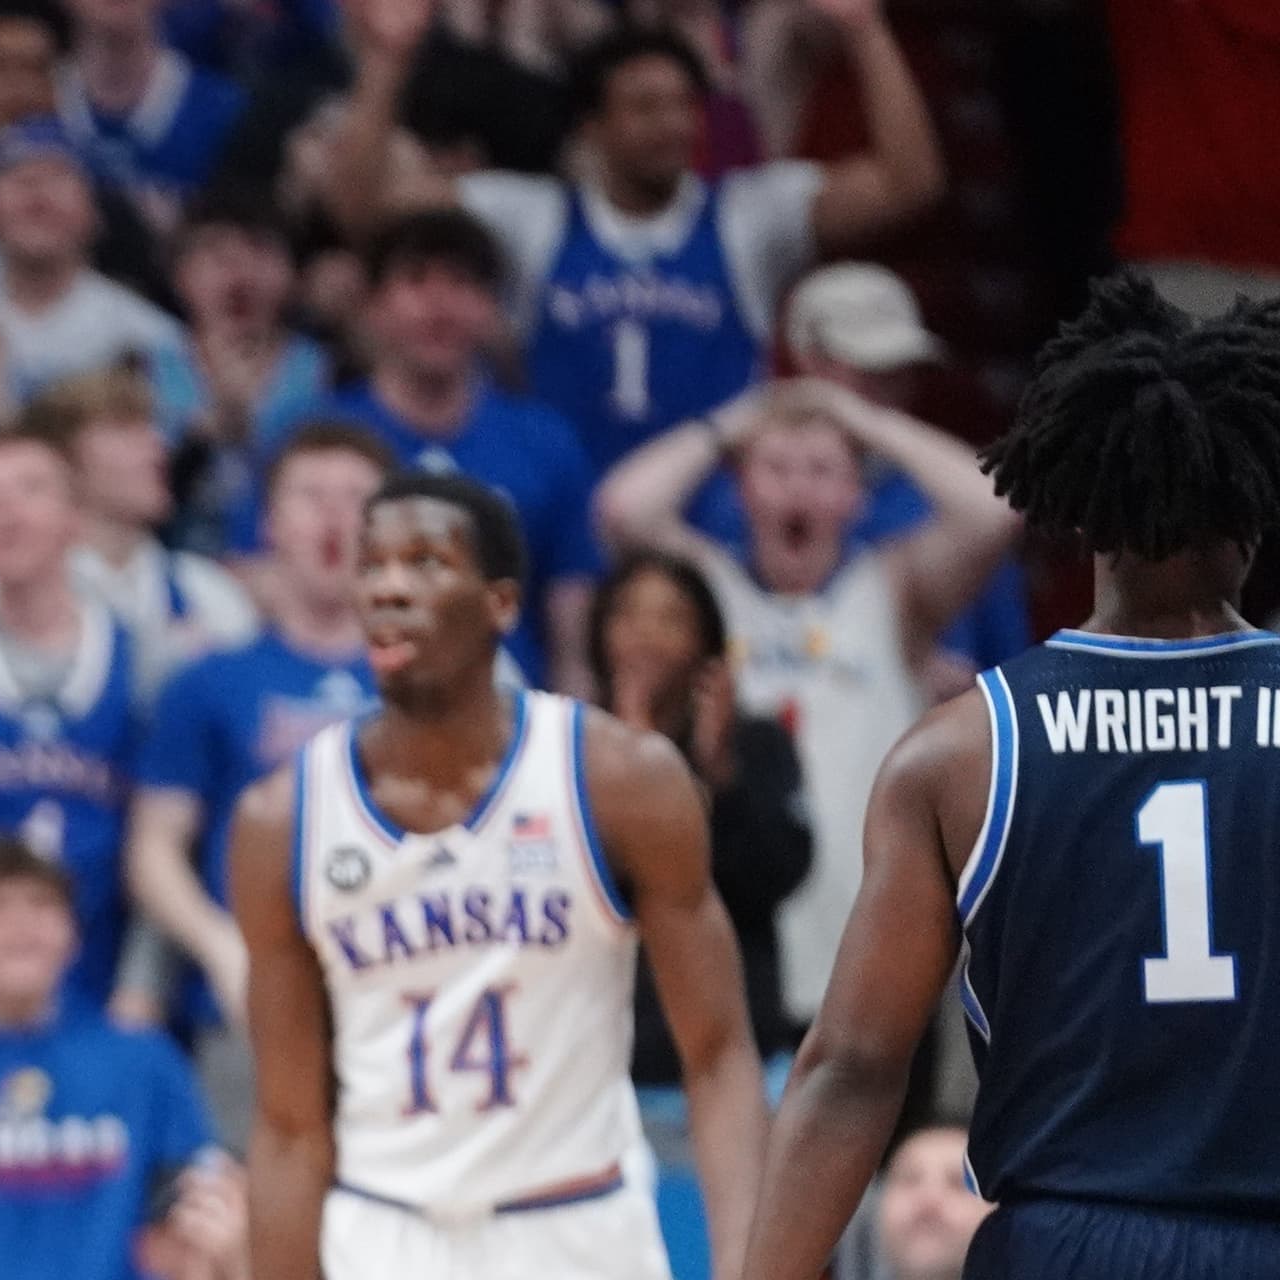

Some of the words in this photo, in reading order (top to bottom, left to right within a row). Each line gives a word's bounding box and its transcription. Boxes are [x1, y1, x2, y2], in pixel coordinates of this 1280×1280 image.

[1036, 685, 1242, 753] WRIGHT
[328, 888, 572, 972] KANSAS
[1134, 778, 1239, 1003] 1
[401, 980, 530, 1117] 14
